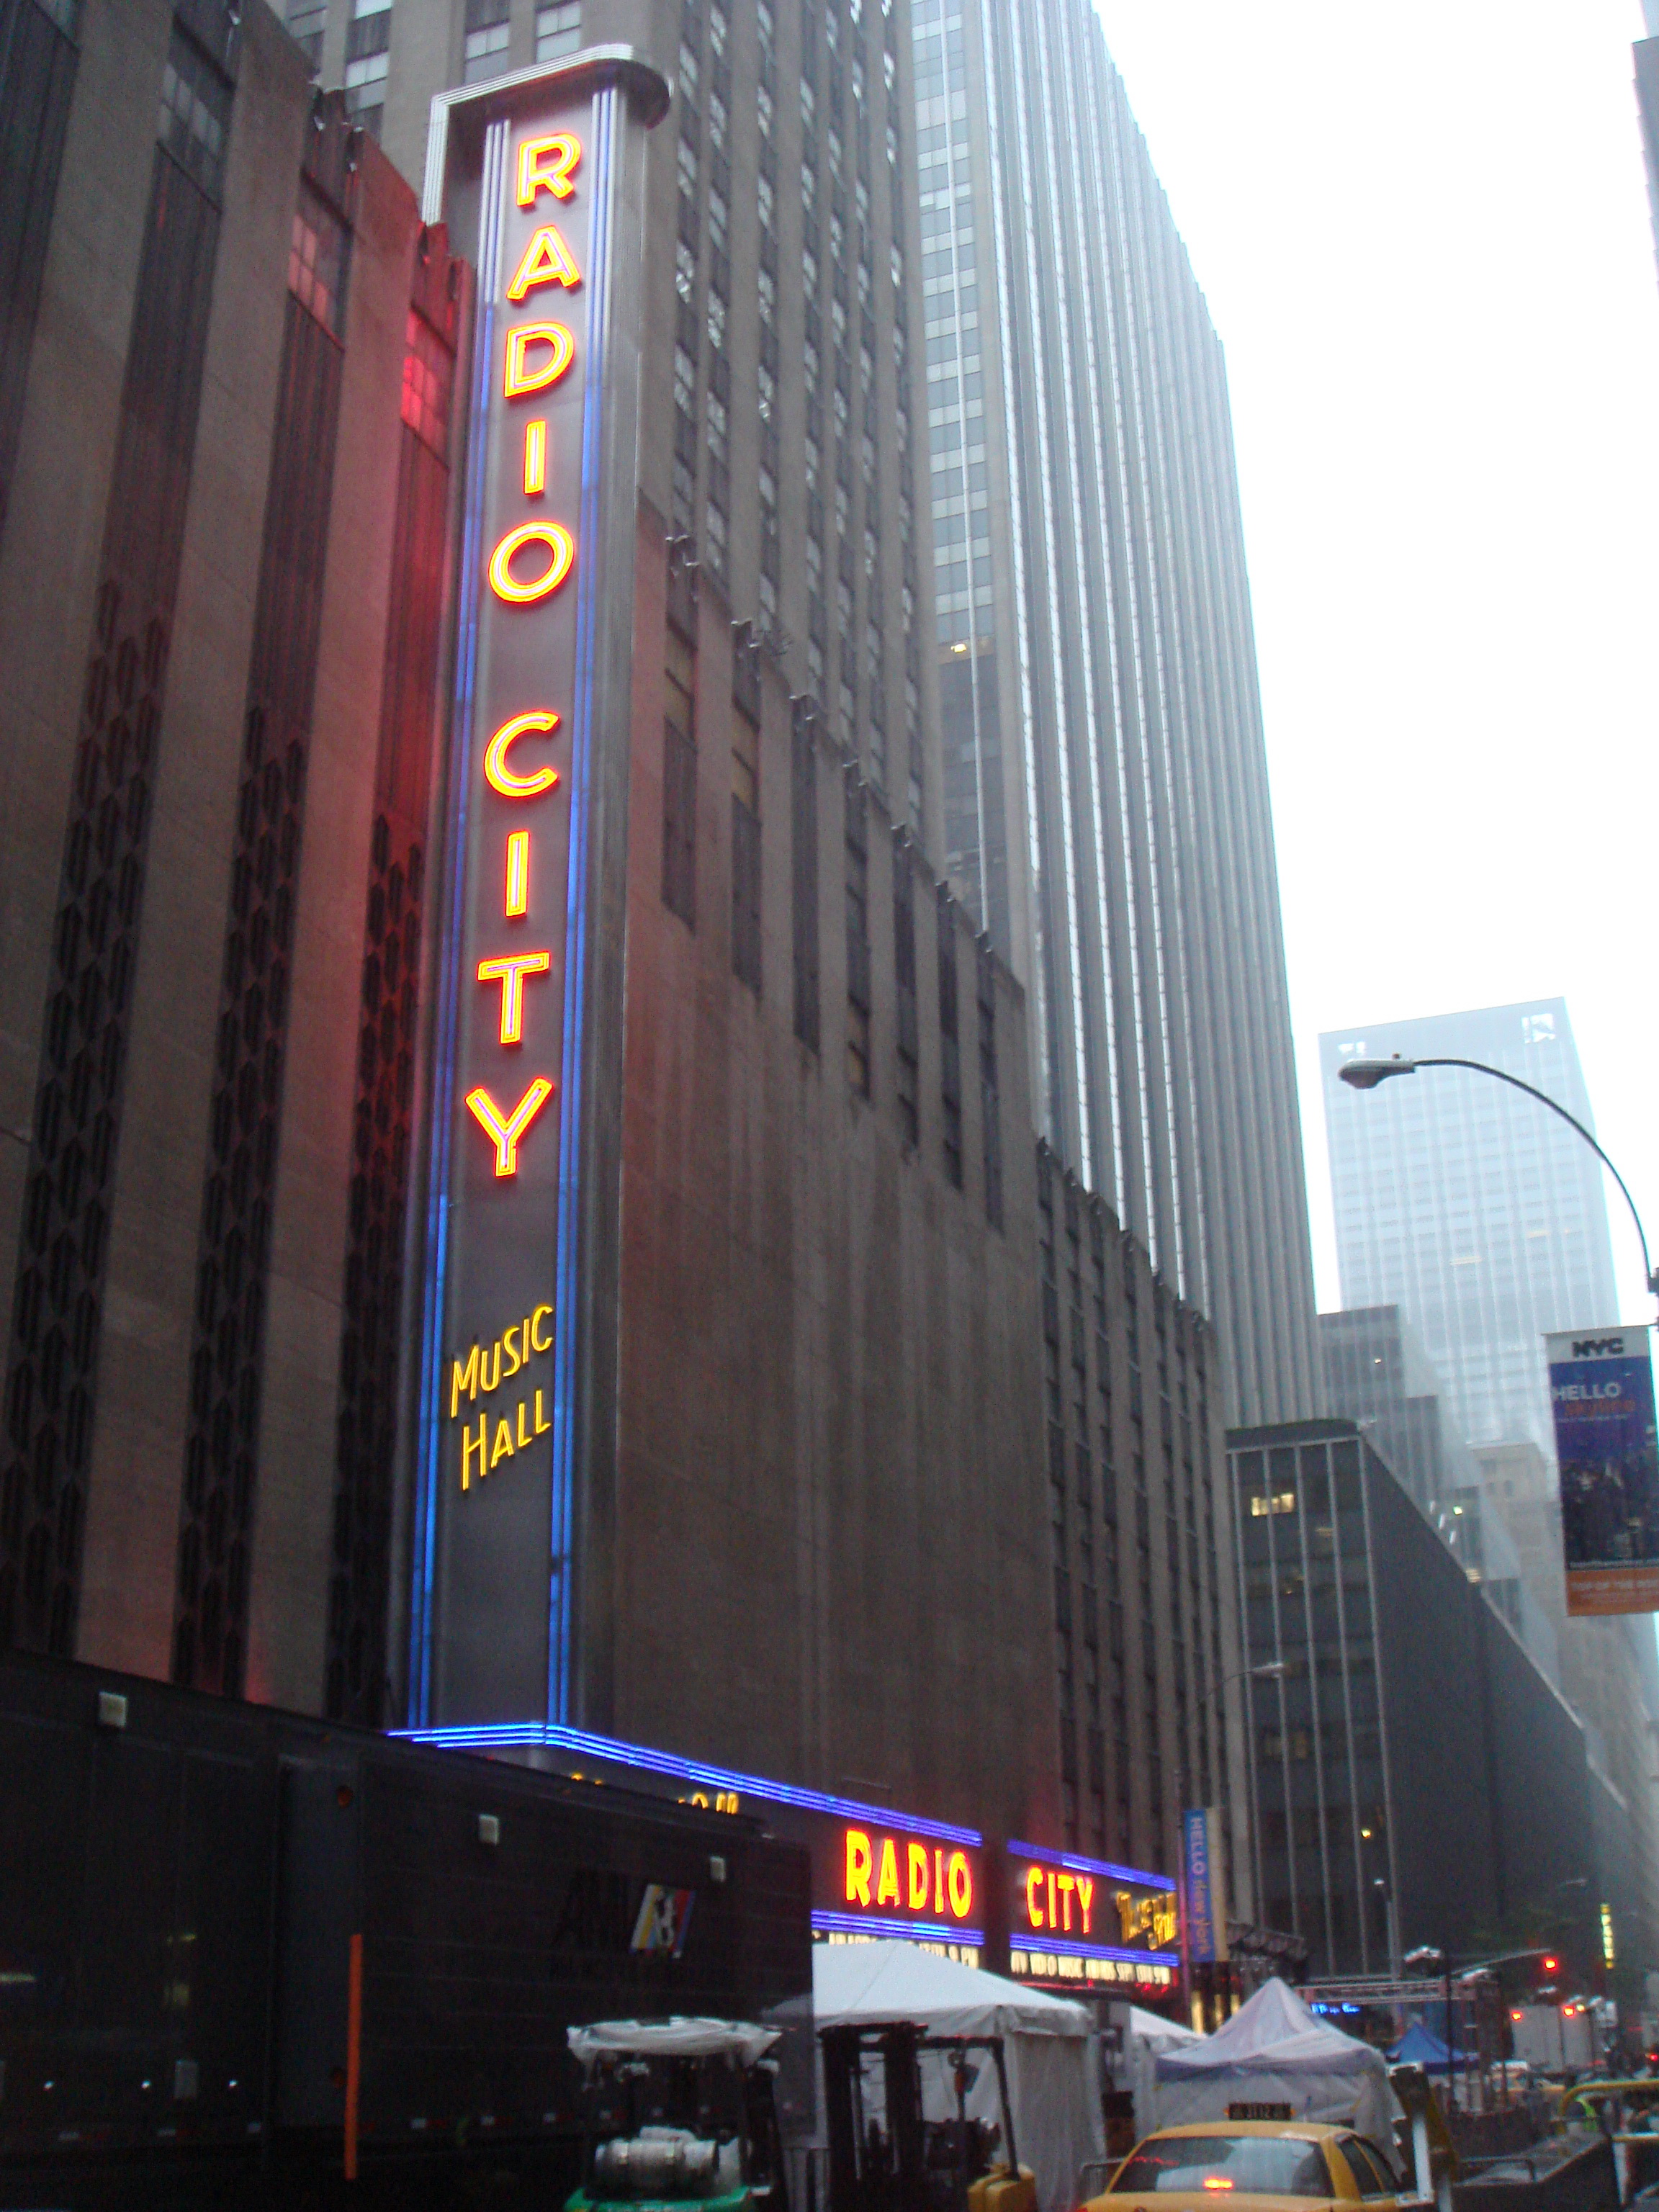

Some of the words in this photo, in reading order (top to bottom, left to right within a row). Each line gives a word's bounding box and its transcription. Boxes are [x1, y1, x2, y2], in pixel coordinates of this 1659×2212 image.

[487, 132, 582, 603] RADIO
[465, 711, 559, 1177] CITY
[451, 1305, 554, 1418] MUSIC
[1551, 1382, 1622, 1401] HELLO
[1572, 1337, 1624, 1357] NYC
[462, 1390, 552, 1491] HALL
[845, 1829, 972, 1918] RADIO
[1025, 1866, 1094, 1935] CITY
